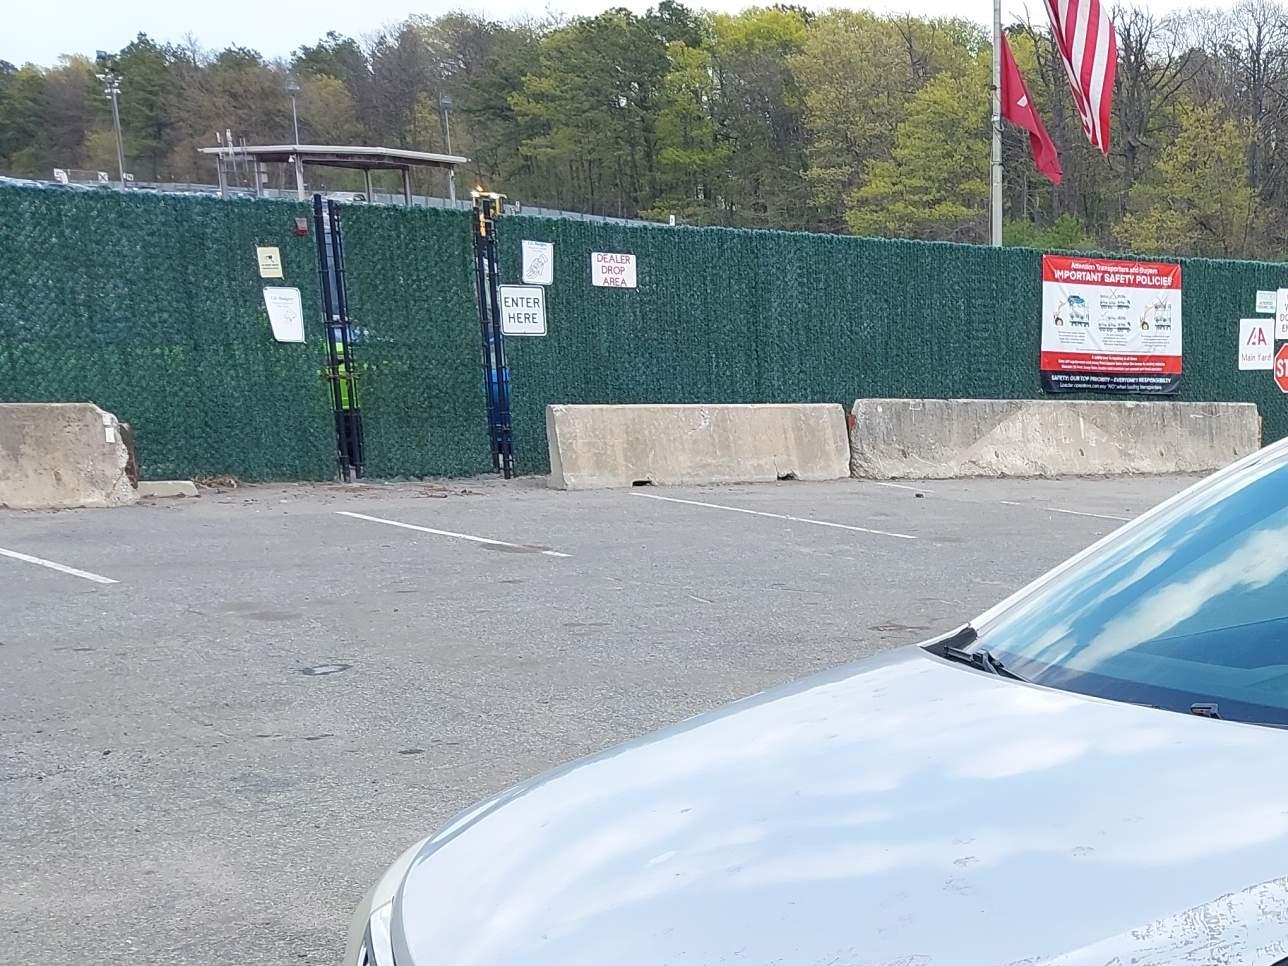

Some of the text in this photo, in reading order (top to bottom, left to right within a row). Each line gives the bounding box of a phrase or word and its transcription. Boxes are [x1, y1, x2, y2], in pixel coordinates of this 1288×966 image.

[596, 253, 631, 265] DEALER
[601, 265, 626, 275] DROP
[1071, 262, 1095, 271] Attention
[1096, 263, 1129, 274] Transporters
[602, 277, 628, 287] AREA
[1054, 269, 1172, 287] IMPORTANT SAFETY POLICIES
[503, 297, 540, 308] ENTER
[508, 312, 539, 324] HERE
[1241, 353, 1272, 361] Main Yard
